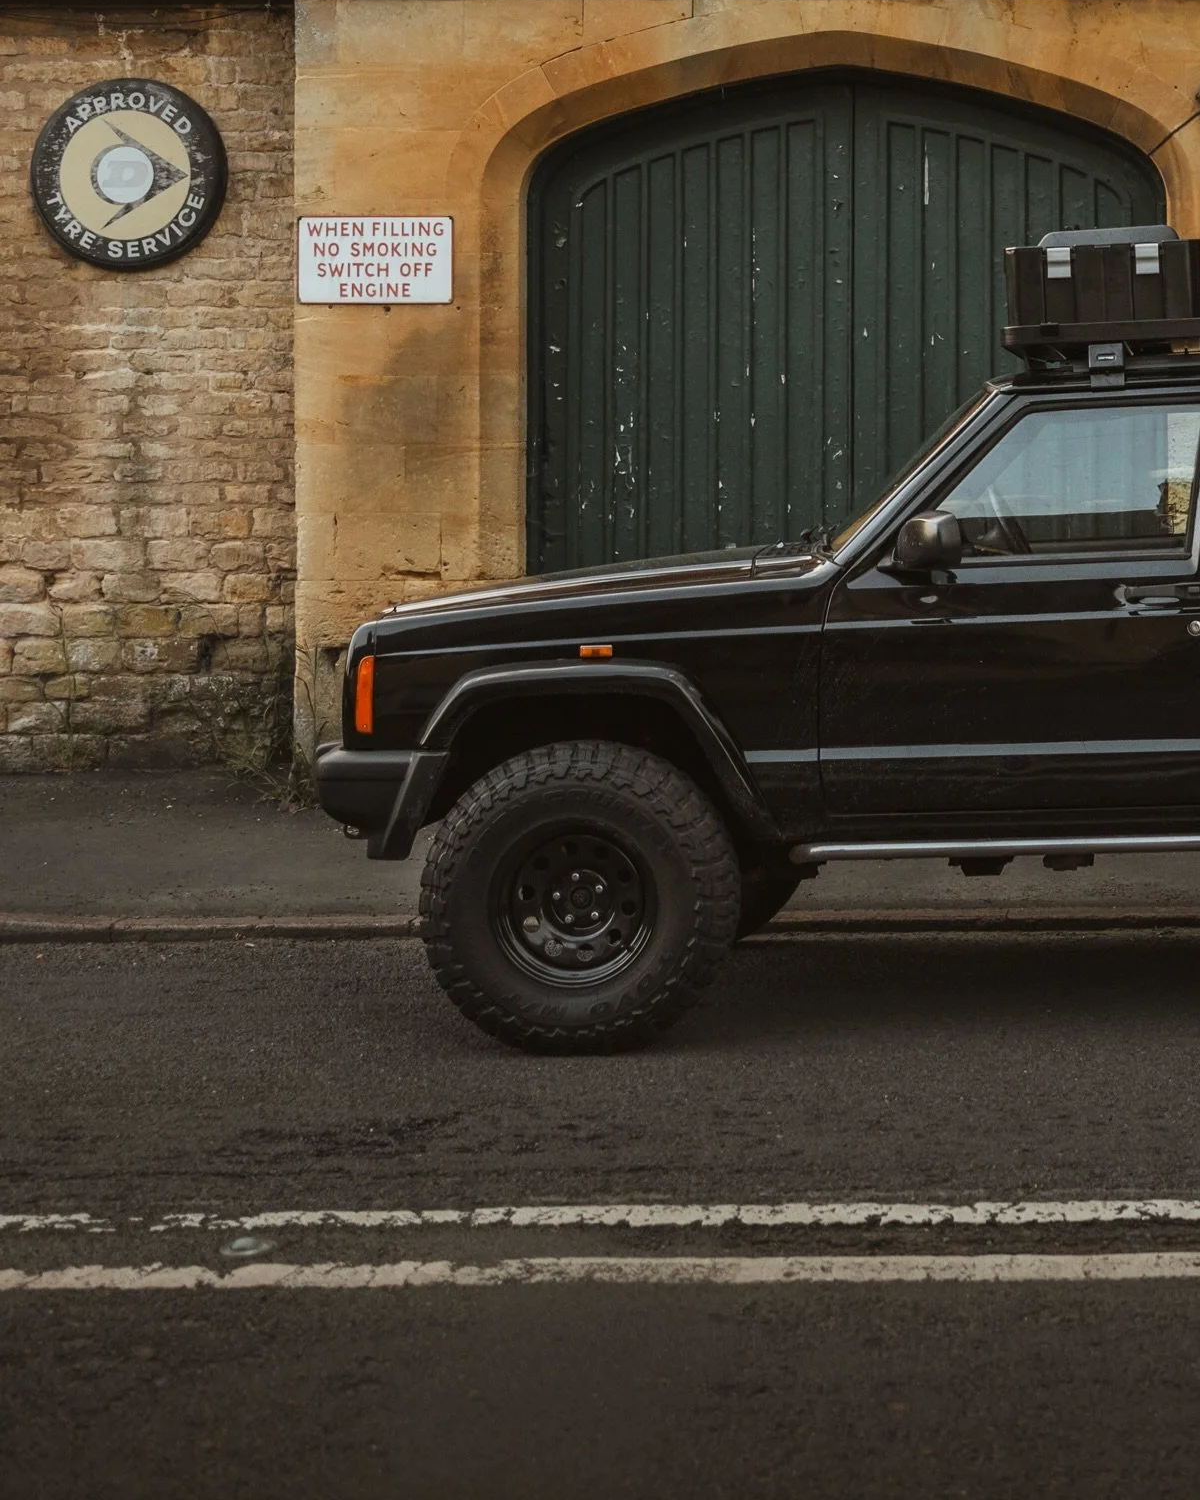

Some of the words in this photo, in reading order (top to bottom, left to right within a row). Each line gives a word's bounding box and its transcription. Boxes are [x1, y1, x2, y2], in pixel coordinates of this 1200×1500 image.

[64, 91, 193, 135] APPROVED
[46, 191, 97, 250] TYRE
[107, 192, 205, 259] SERVICE
[307, 222, 364, 237] WHEN
[372, 222, 445, 237] FILLING
[313, 242, 340, 257] NO
[350, 242, 438, 257] SMOKING
[317, 262, 390, 278] SWITCH
[400, 262, 433, 277] OFF
[339, 283, 411, 298] ENGINE
